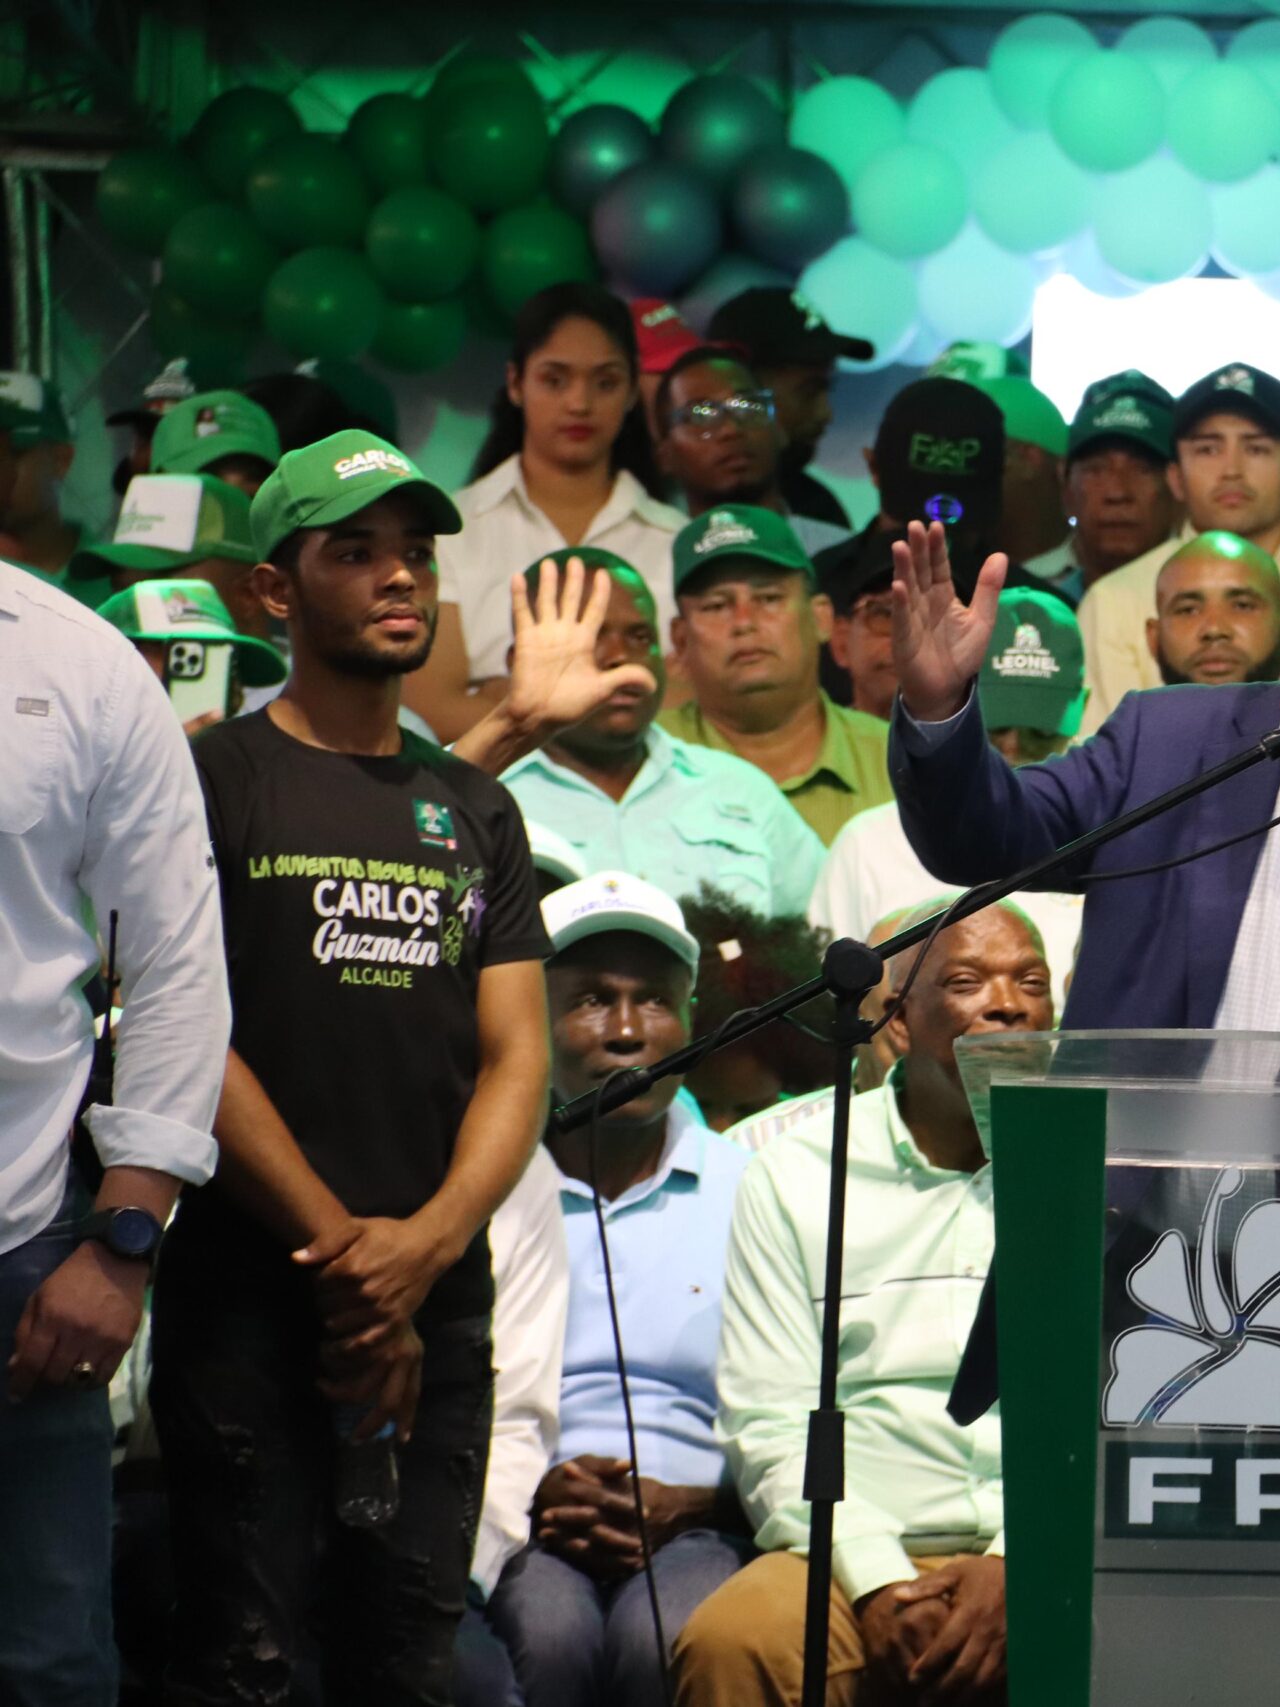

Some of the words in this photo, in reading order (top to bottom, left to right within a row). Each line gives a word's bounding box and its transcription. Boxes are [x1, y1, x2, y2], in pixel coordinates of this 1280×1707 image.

[992, 654, 1061, 673] LEONEL
[249, 855, 272, 879] LA
[312, 879, 440, 926] CARLOS
[312, 918, 440, 967] Guzmán
[339, 966, 413, 988] ALCALDE
